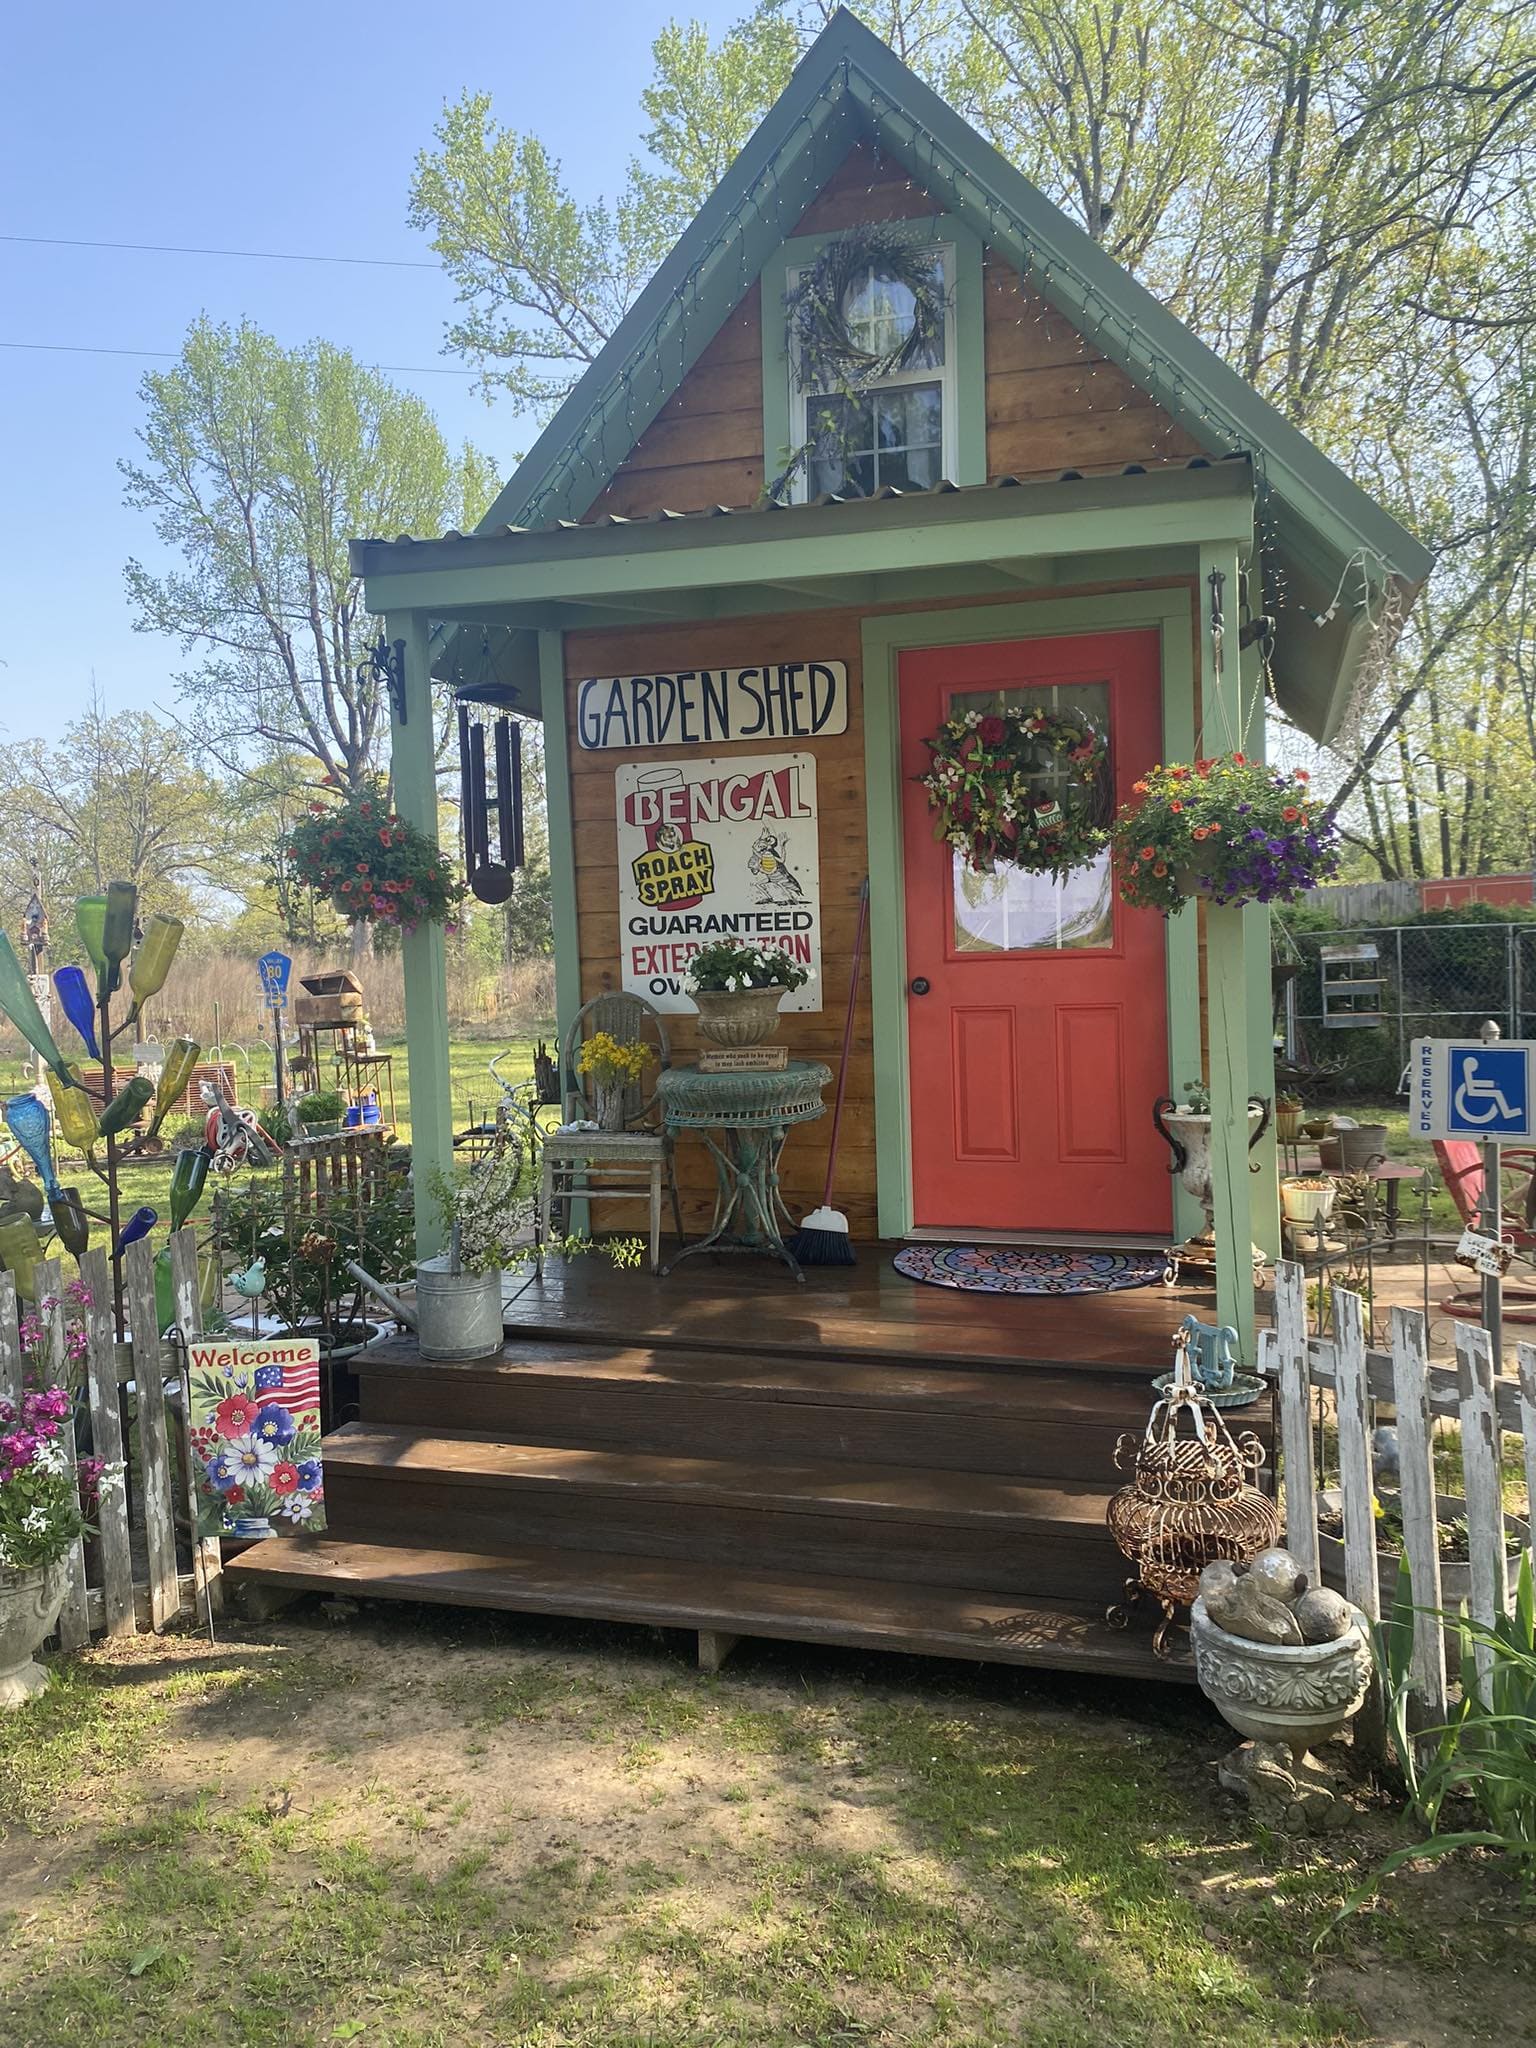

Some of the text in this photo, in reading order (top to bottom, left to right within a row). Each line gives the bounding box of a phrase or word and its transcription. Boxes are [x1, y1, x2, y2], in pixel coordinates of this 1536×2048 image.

[579, 663, 836, 748] GARDEN SHED
[632, 765, 812, 827] BENGAL
[637, 847, 709, 880] ROACH
[643, 869, 710, 901] SPRAY
[628, 911, 814, 936] GUARANTEED
[1420, 1046, 1433, 1132] RESERVED
[191, 1348, 311, 1368] Welcome
